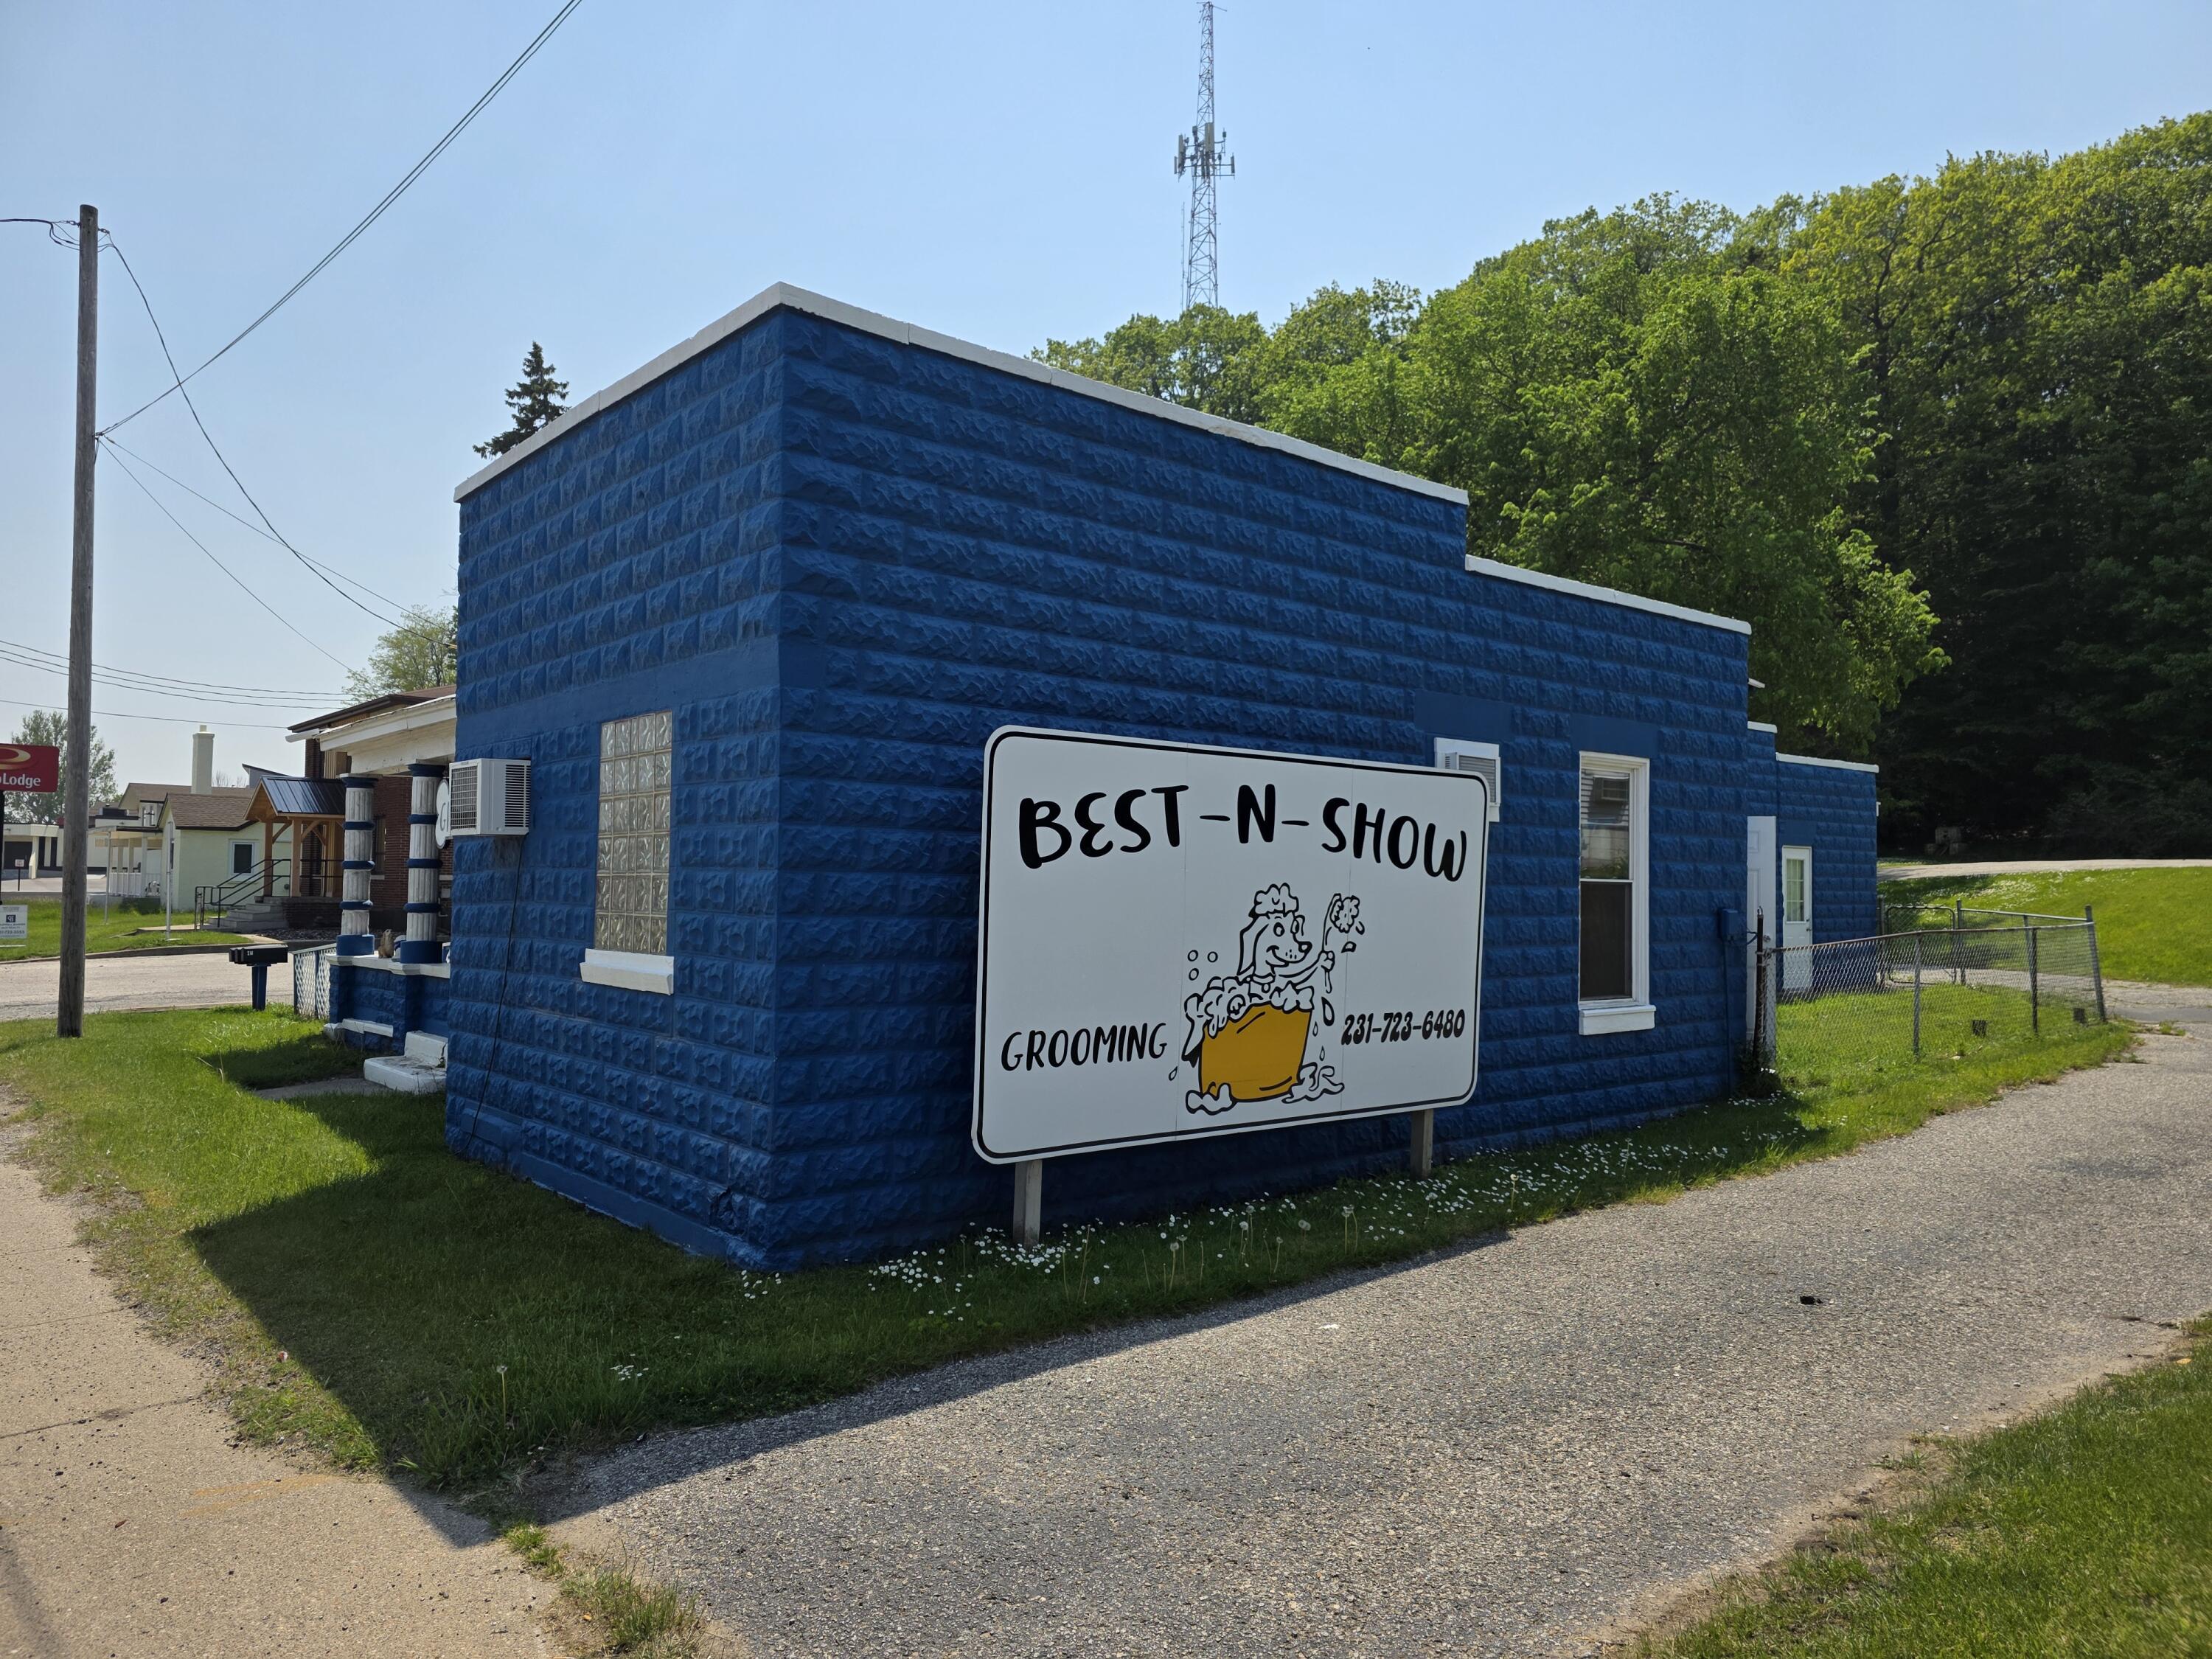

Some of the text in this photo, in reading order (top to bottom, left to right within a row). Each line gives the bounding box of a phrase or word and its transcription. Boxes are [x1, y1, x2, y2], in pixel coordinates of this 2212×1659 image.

[0, 773, 41, 789] Lodge
[1340, 1009, 1466, 1046] 231-723-6480
[1001, 1022, 1167, 1071] GROOMING
